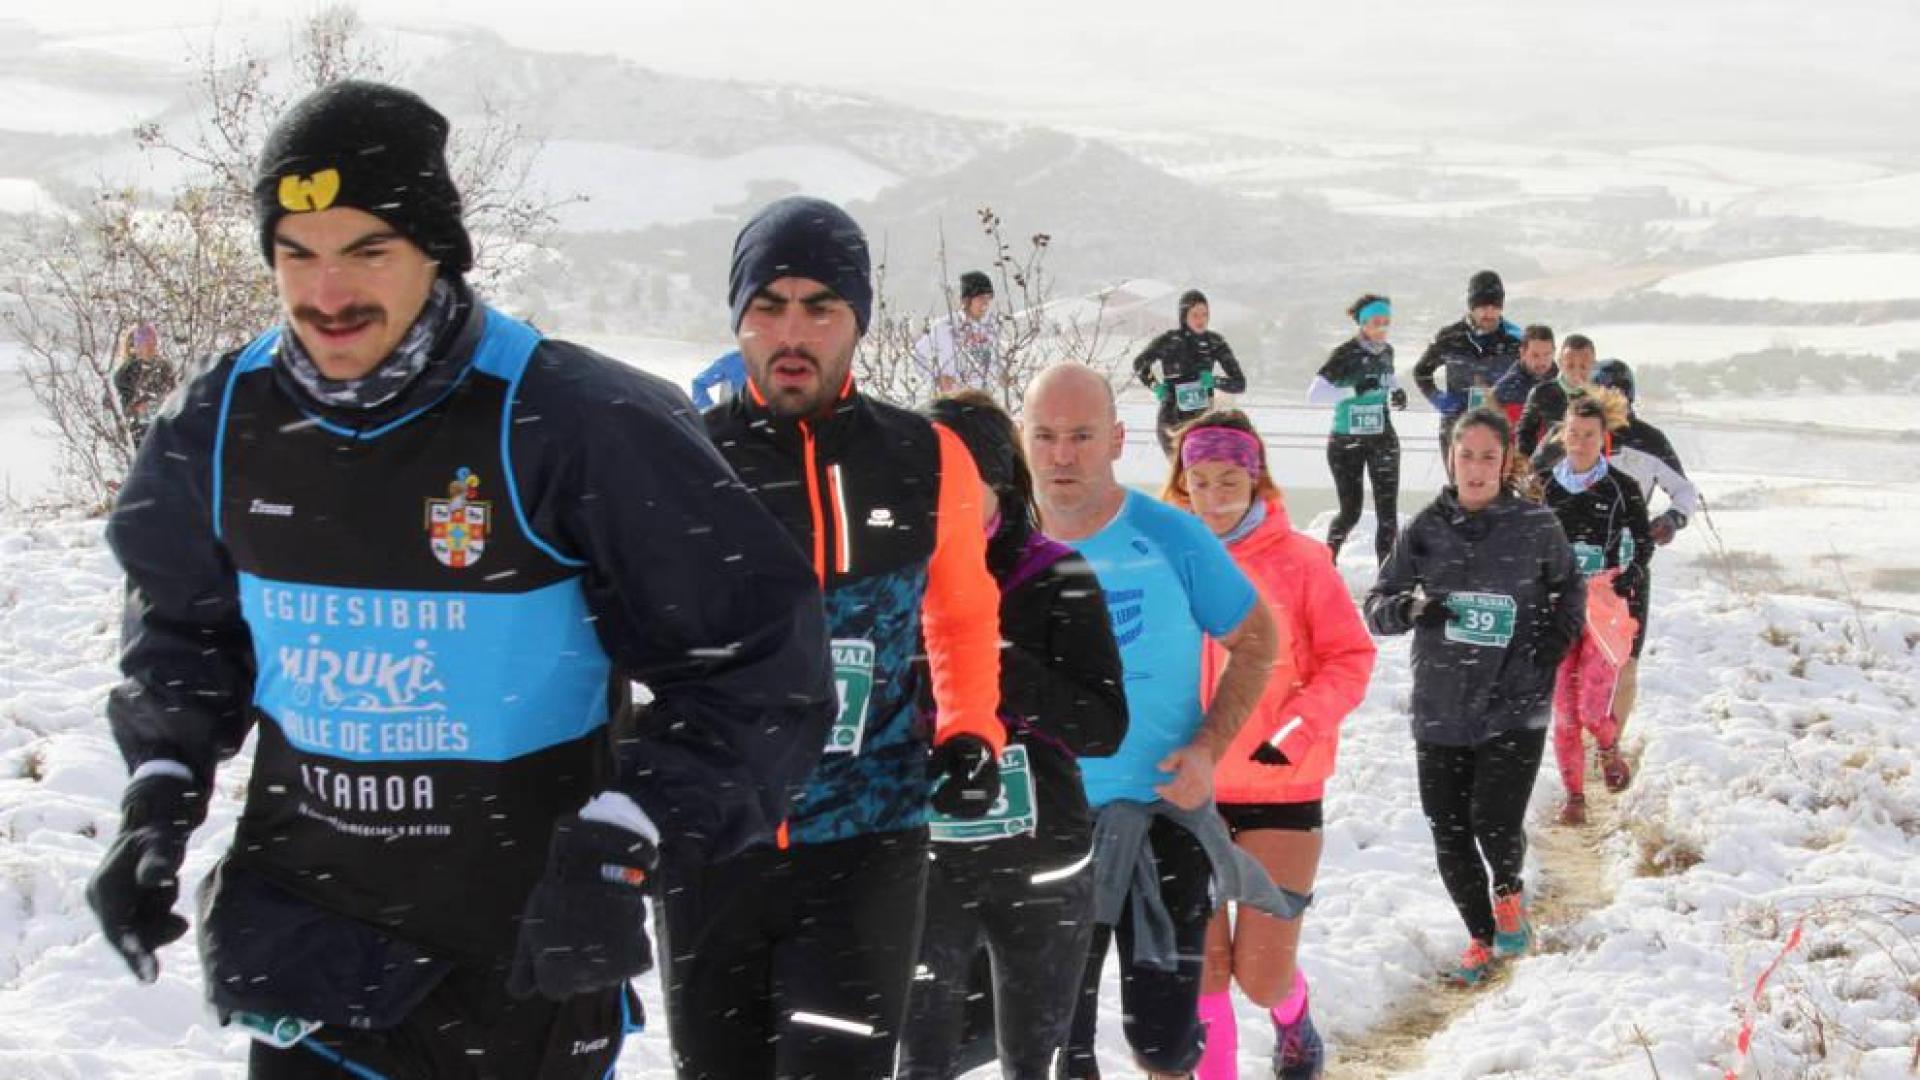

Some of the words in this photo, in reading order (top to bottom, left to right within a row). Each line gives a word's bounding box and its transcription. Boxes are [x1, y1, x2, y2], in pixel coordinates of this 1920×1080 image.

[263, 588, 466, 630] EGUESIBAR
[1465, 608, 1496, 631] 39
[341, 721, 372, 753] DE
[380, 715, 469, 753] EGÜÉS
[301, 764, 435, 811] ITAROA
